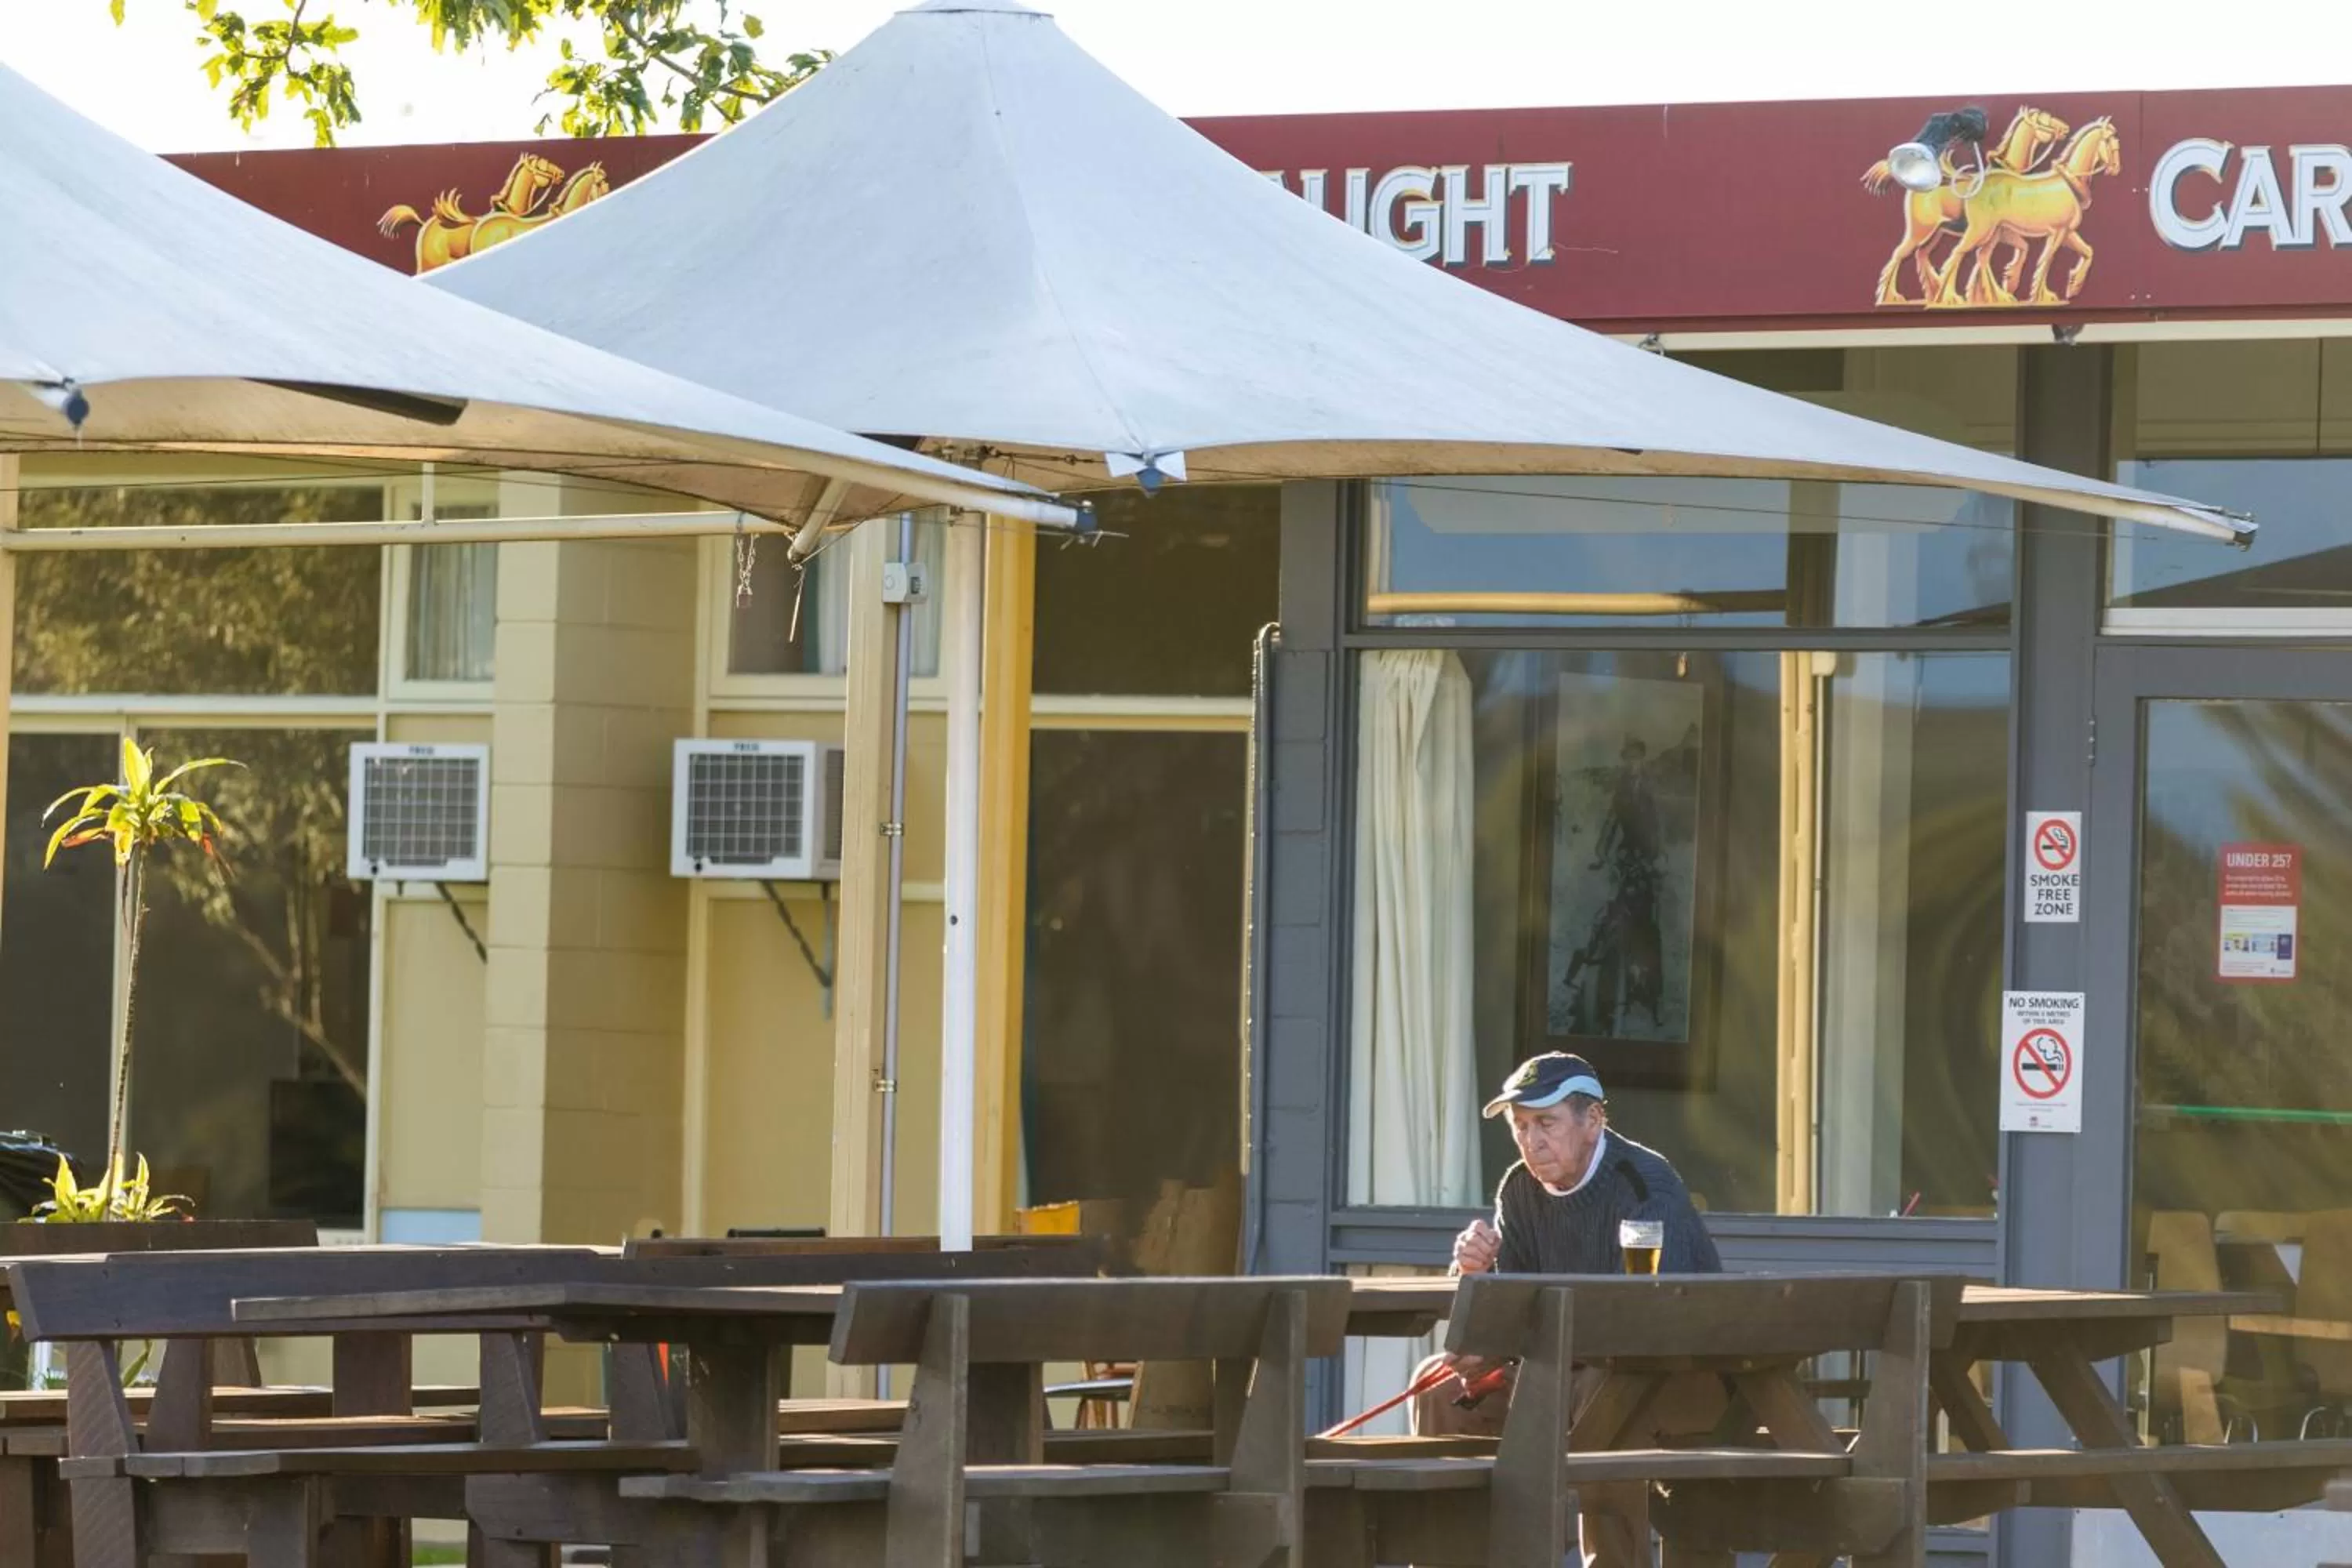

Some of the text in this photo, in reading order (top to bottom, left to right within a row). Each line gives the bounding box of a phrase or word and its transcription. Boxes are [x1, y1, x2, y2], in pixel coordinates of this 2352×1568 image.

[2148, 137, 2352, 253] CAR
[1258, 162, 1572, 267] GHT
[2227, 852, 2270, 868] UNDER
[2030, 874, 2080, 887] SMOKE
[2038, 888, 2071, 901] FREE
[2034, 902, 2074, 915] ZONE
[2009, 996, 2079, 1009] NO SMOKING
